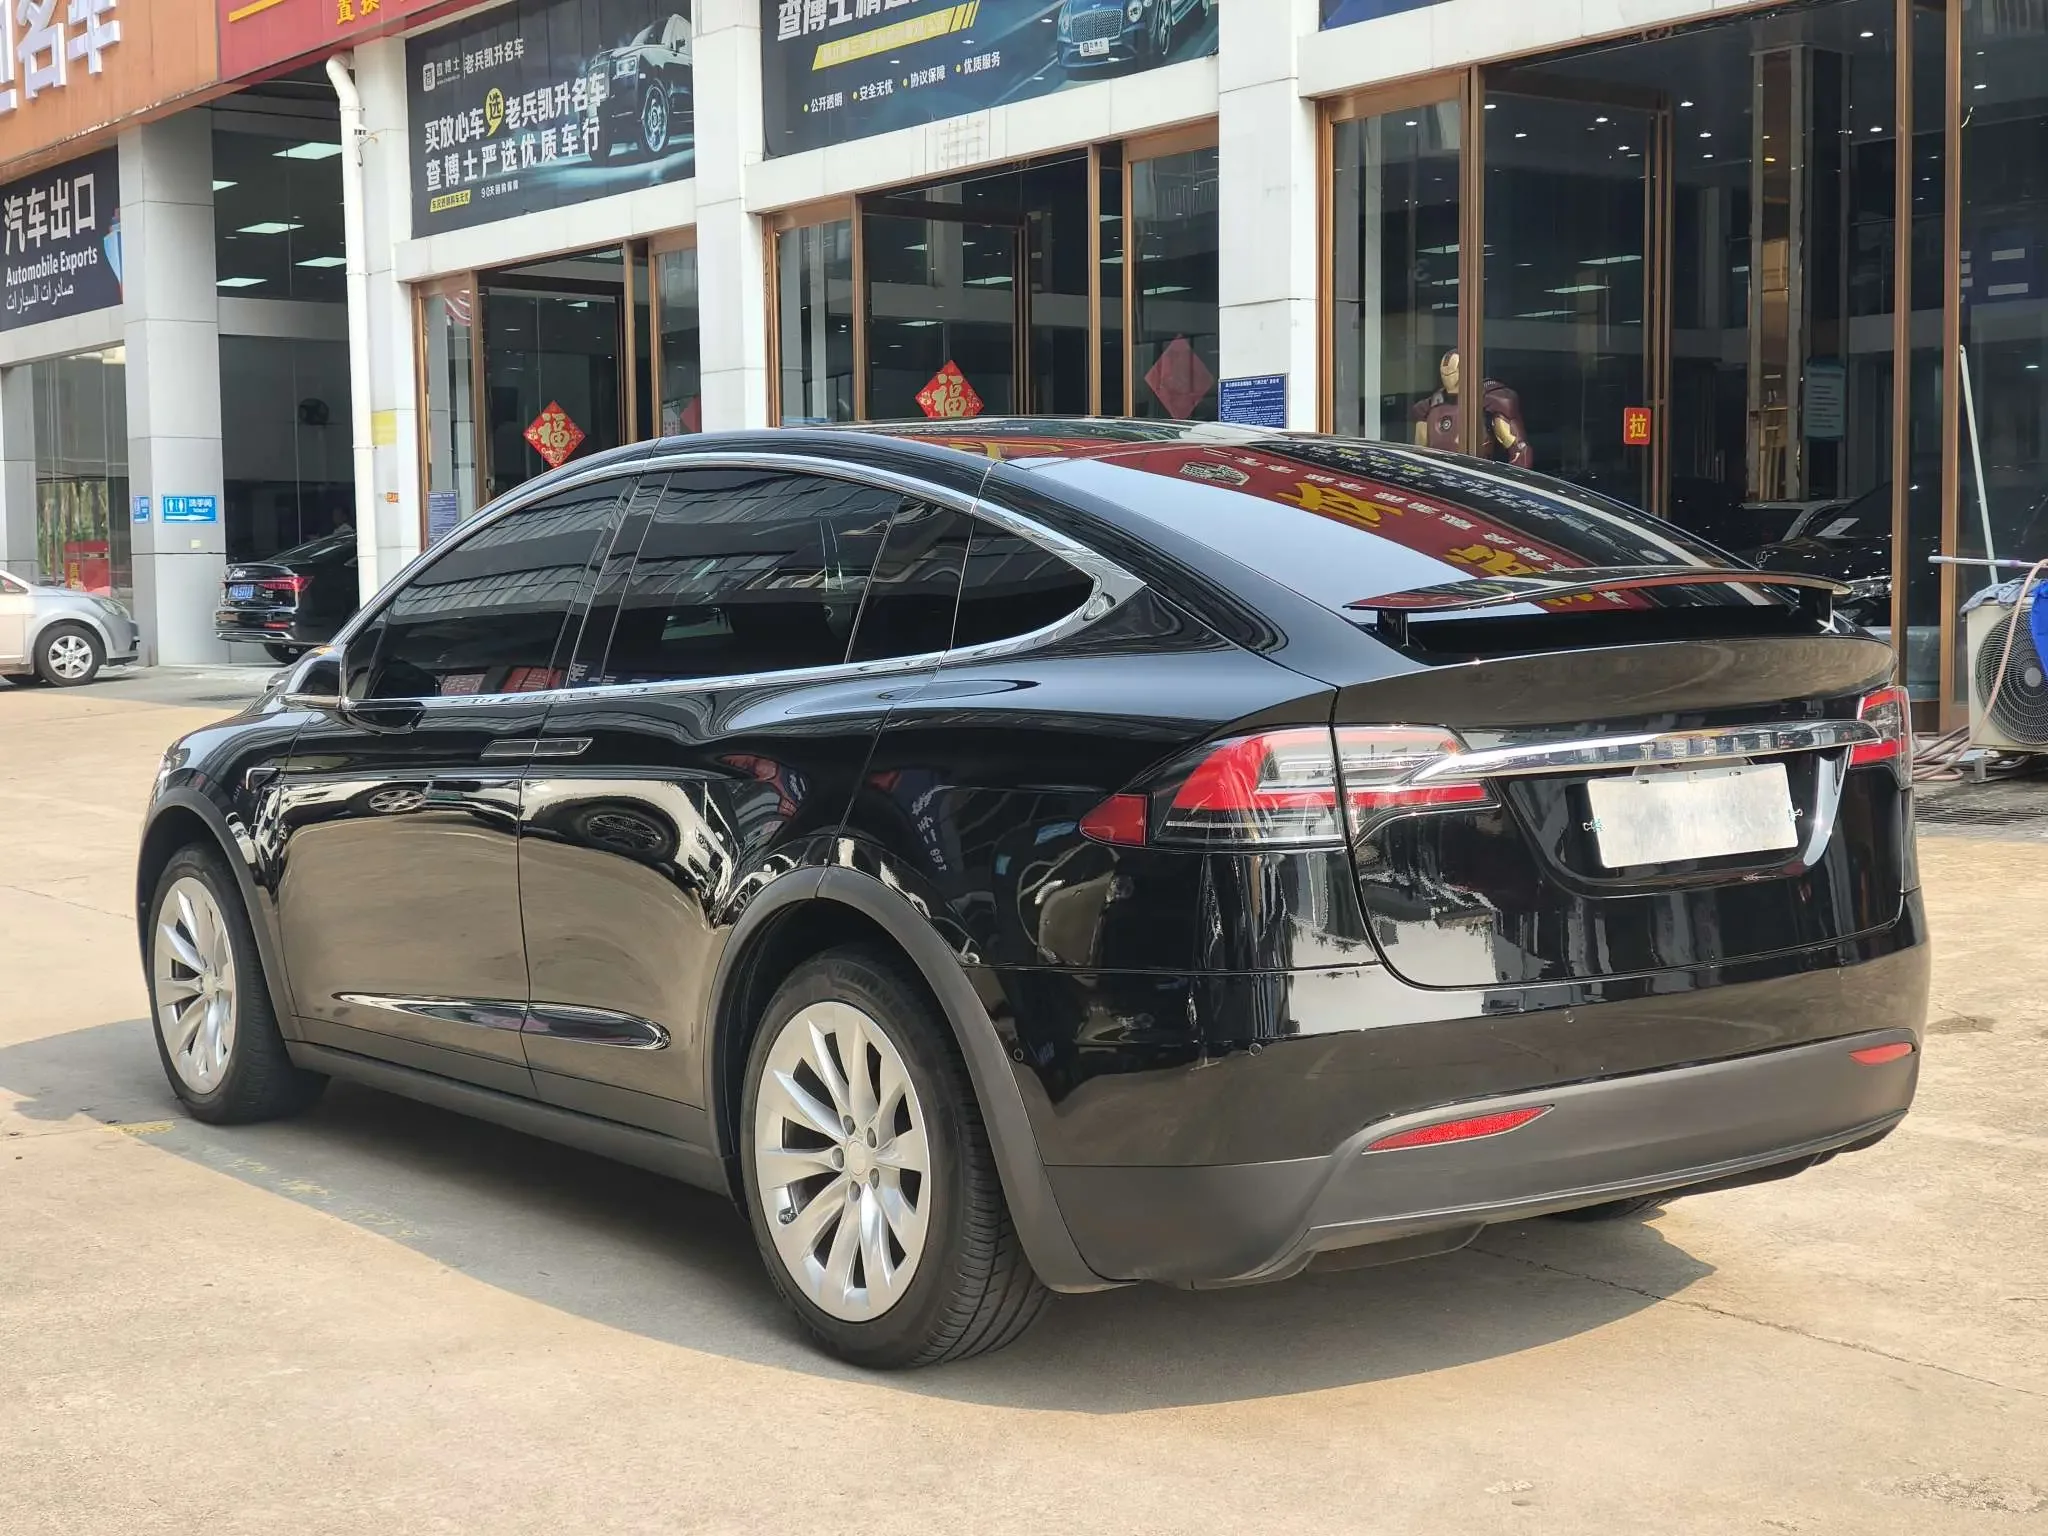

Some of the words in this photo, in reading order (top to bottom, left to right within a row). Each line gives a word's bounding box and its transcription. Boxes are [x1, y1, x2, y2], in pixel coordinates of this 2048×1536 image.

[0, 0, 120, 109] 名车
[465, 38, 524, 74] 老兵凯升名车
[811, 92, 843, 113] 公开透明
[859, 79, 893, 101] 安全无忧
[910, 65, 946, 88] 协议保障
[964, 52, 1000, 75] 优质服务
[426, 117, 600, 191] 查博士严选优质车行
[4, 173, 95, 256] 汽车出口
[6, 253, 58, 287] Automobile
[60, 245, 98, 275] Exports
[932, 373, 967, 418] 福
[537, 412, 570, 448] 福
[1630, 413, 1647, 439] 拉
[1640, 734, 1771, 761] TESLA
